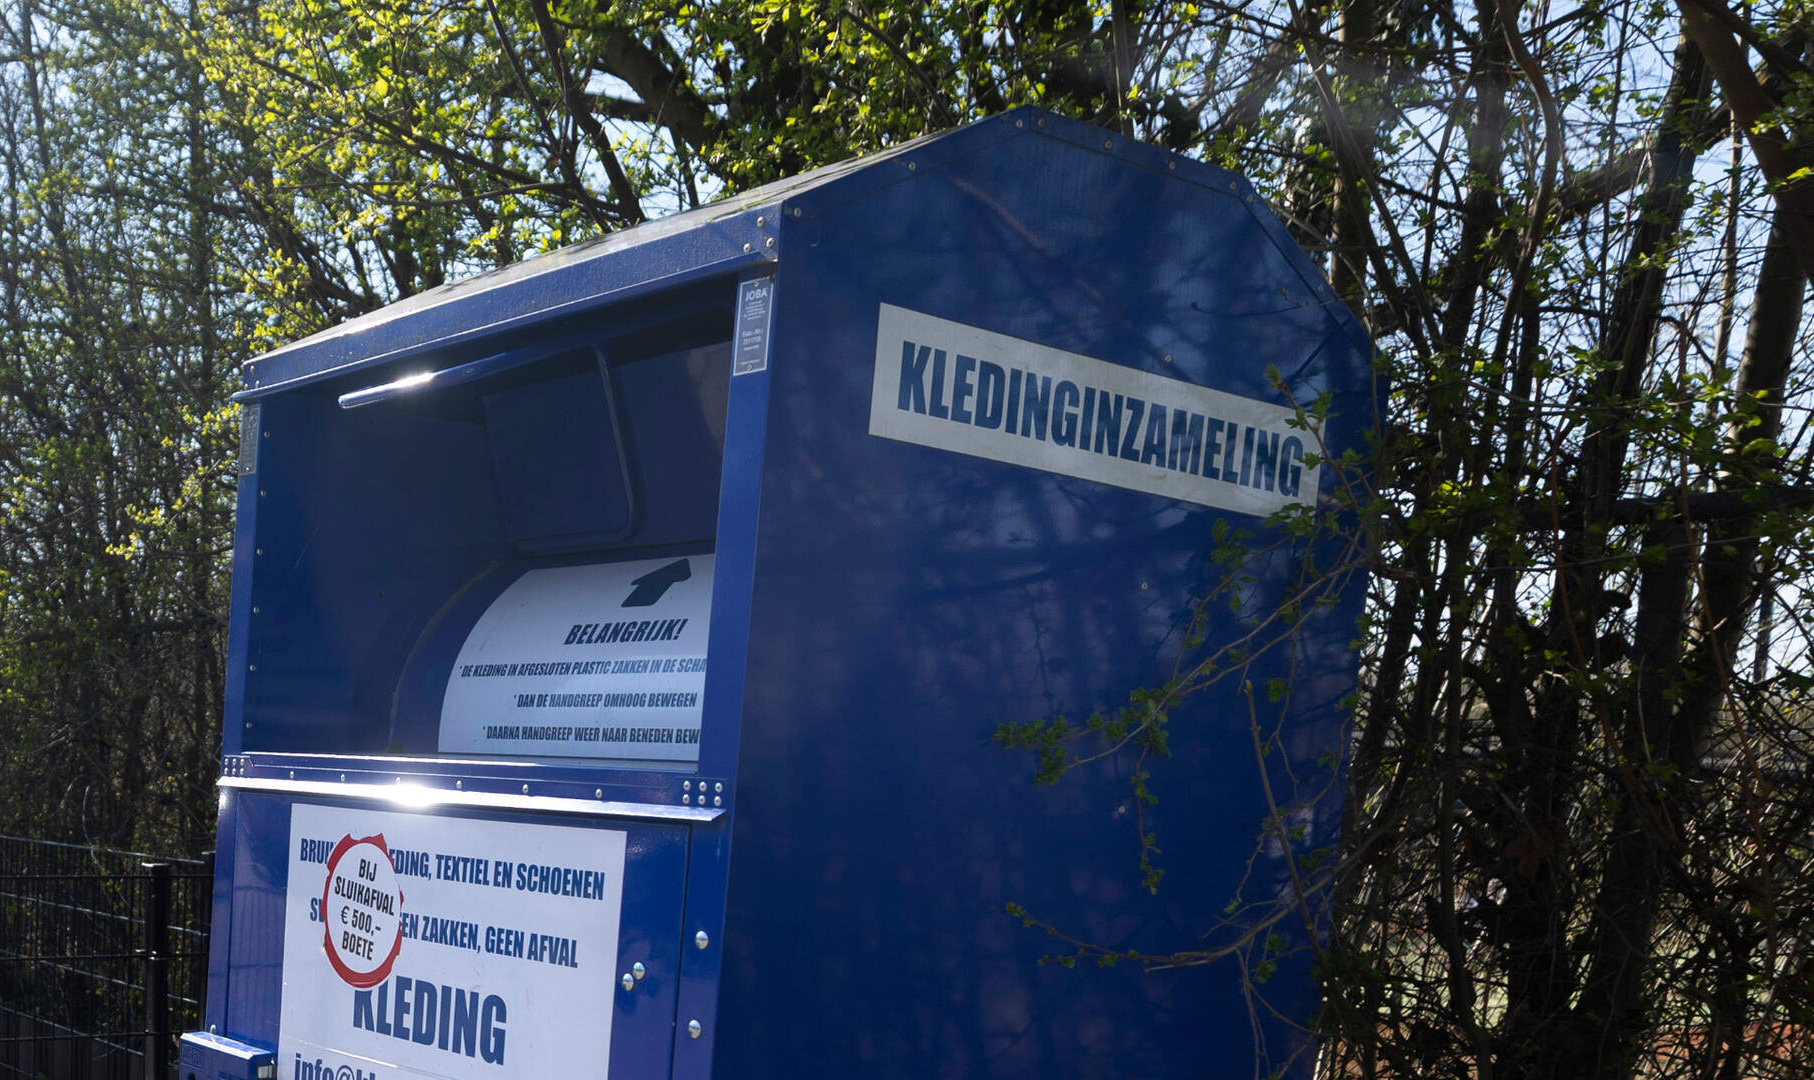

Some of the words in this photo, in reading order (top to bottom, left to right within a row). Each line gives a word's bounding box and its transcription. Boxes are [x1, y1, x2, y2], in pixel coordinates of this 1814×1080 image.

[746, 288, 768, 301] JOBA
[898, 340, 1304, 498] KLEDINGINZAMELING
[563, 618, 688, 645] BELANGRIJK!
[473, 664, 507, 677] KLEDING
[507, 663, 519, 676] IN
[518, 662, 573, 676] AFGESLOTEN
[571, 660, 611, 675] PLASTIC
[610, 659, 650, 674] ZAKKEN
[649, 659, 661, 673] IN
[662, 659, 678, 673] DE
[536, 694, 548, 708] DE
[548, 694, 603, 708] HANDGREEP
[603, 693, 647, 708] OMHOOG
[647, 692, 698, 708] BEWEGEN
[521, 726, 573, 741] HANDGREEP
[574, 727, 601, 742] WEER
[601, 727, 628, 743] NAAR
[629, 727, 674, 744] BENEDEN
[358, 858, 378, 883] BIJ
[436, 854, 490, 886] TEXTIEL
[493, 860, 513, 889] EN
[516, 862, 605, 901] SCHOENEN
[342, 930, 374, 961] BOETE
[421, 915, 481, 954] ZAKKEN,
[485, 926, 525, 959] GEEN
[527, 933, 578, 969] AFVAL
[353, 975, 507, 1066] KLEDING
